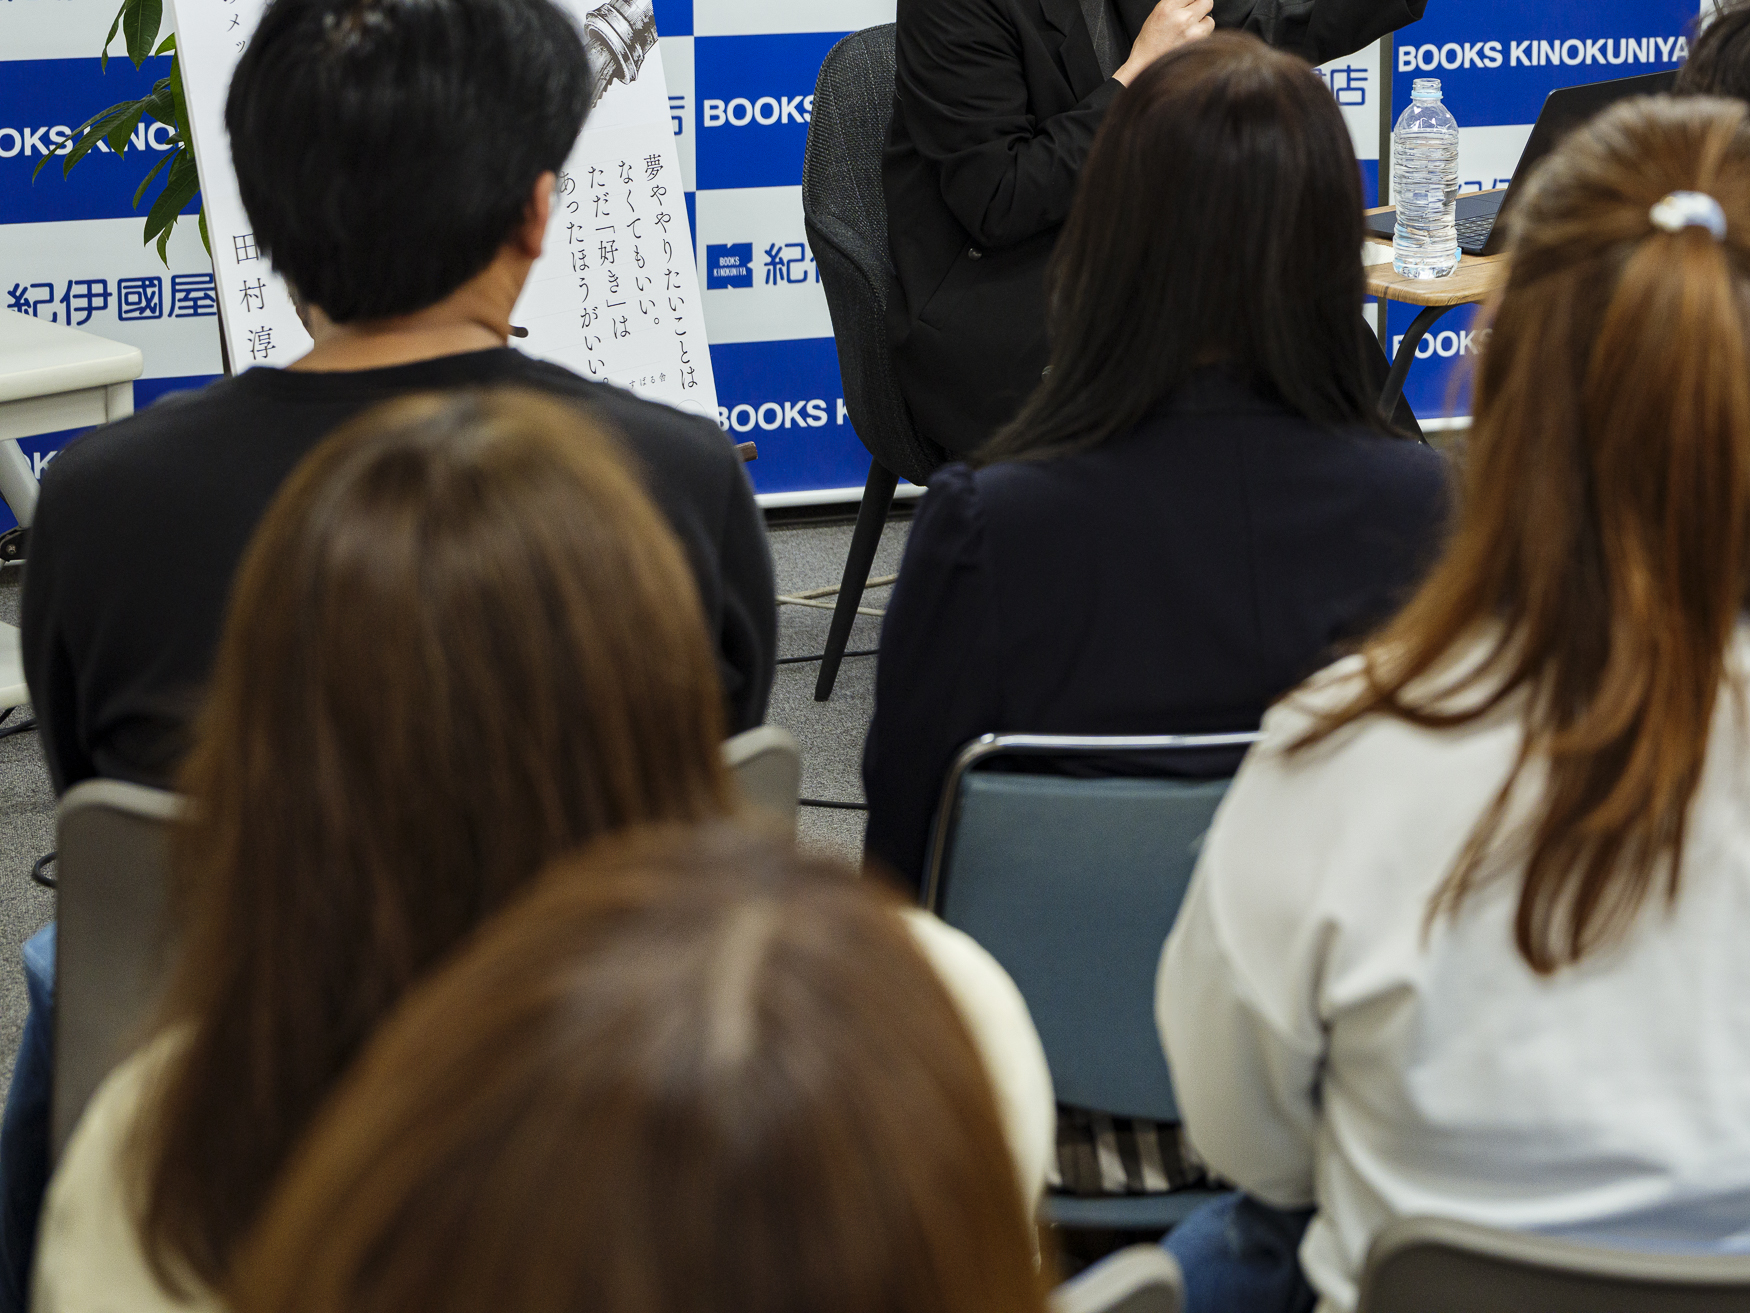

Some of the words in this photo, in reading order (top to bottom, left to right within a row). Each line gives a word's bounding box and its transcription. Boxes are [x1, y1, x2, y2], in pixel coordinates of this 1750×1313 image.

[1399, 42, 1502, 72] BOOKS
[1510, 36, 1689, 66] KINOKUNIYA
[233, 232, 276, 361] 田村淳
[588, 166, 631, 339] ただ「好き」は
[618, 160, 660, 325] なくてもいい。
[643, 153, 698, 390] 夢ややりたいことは
[720, 256, 739, 266] BOOKS
